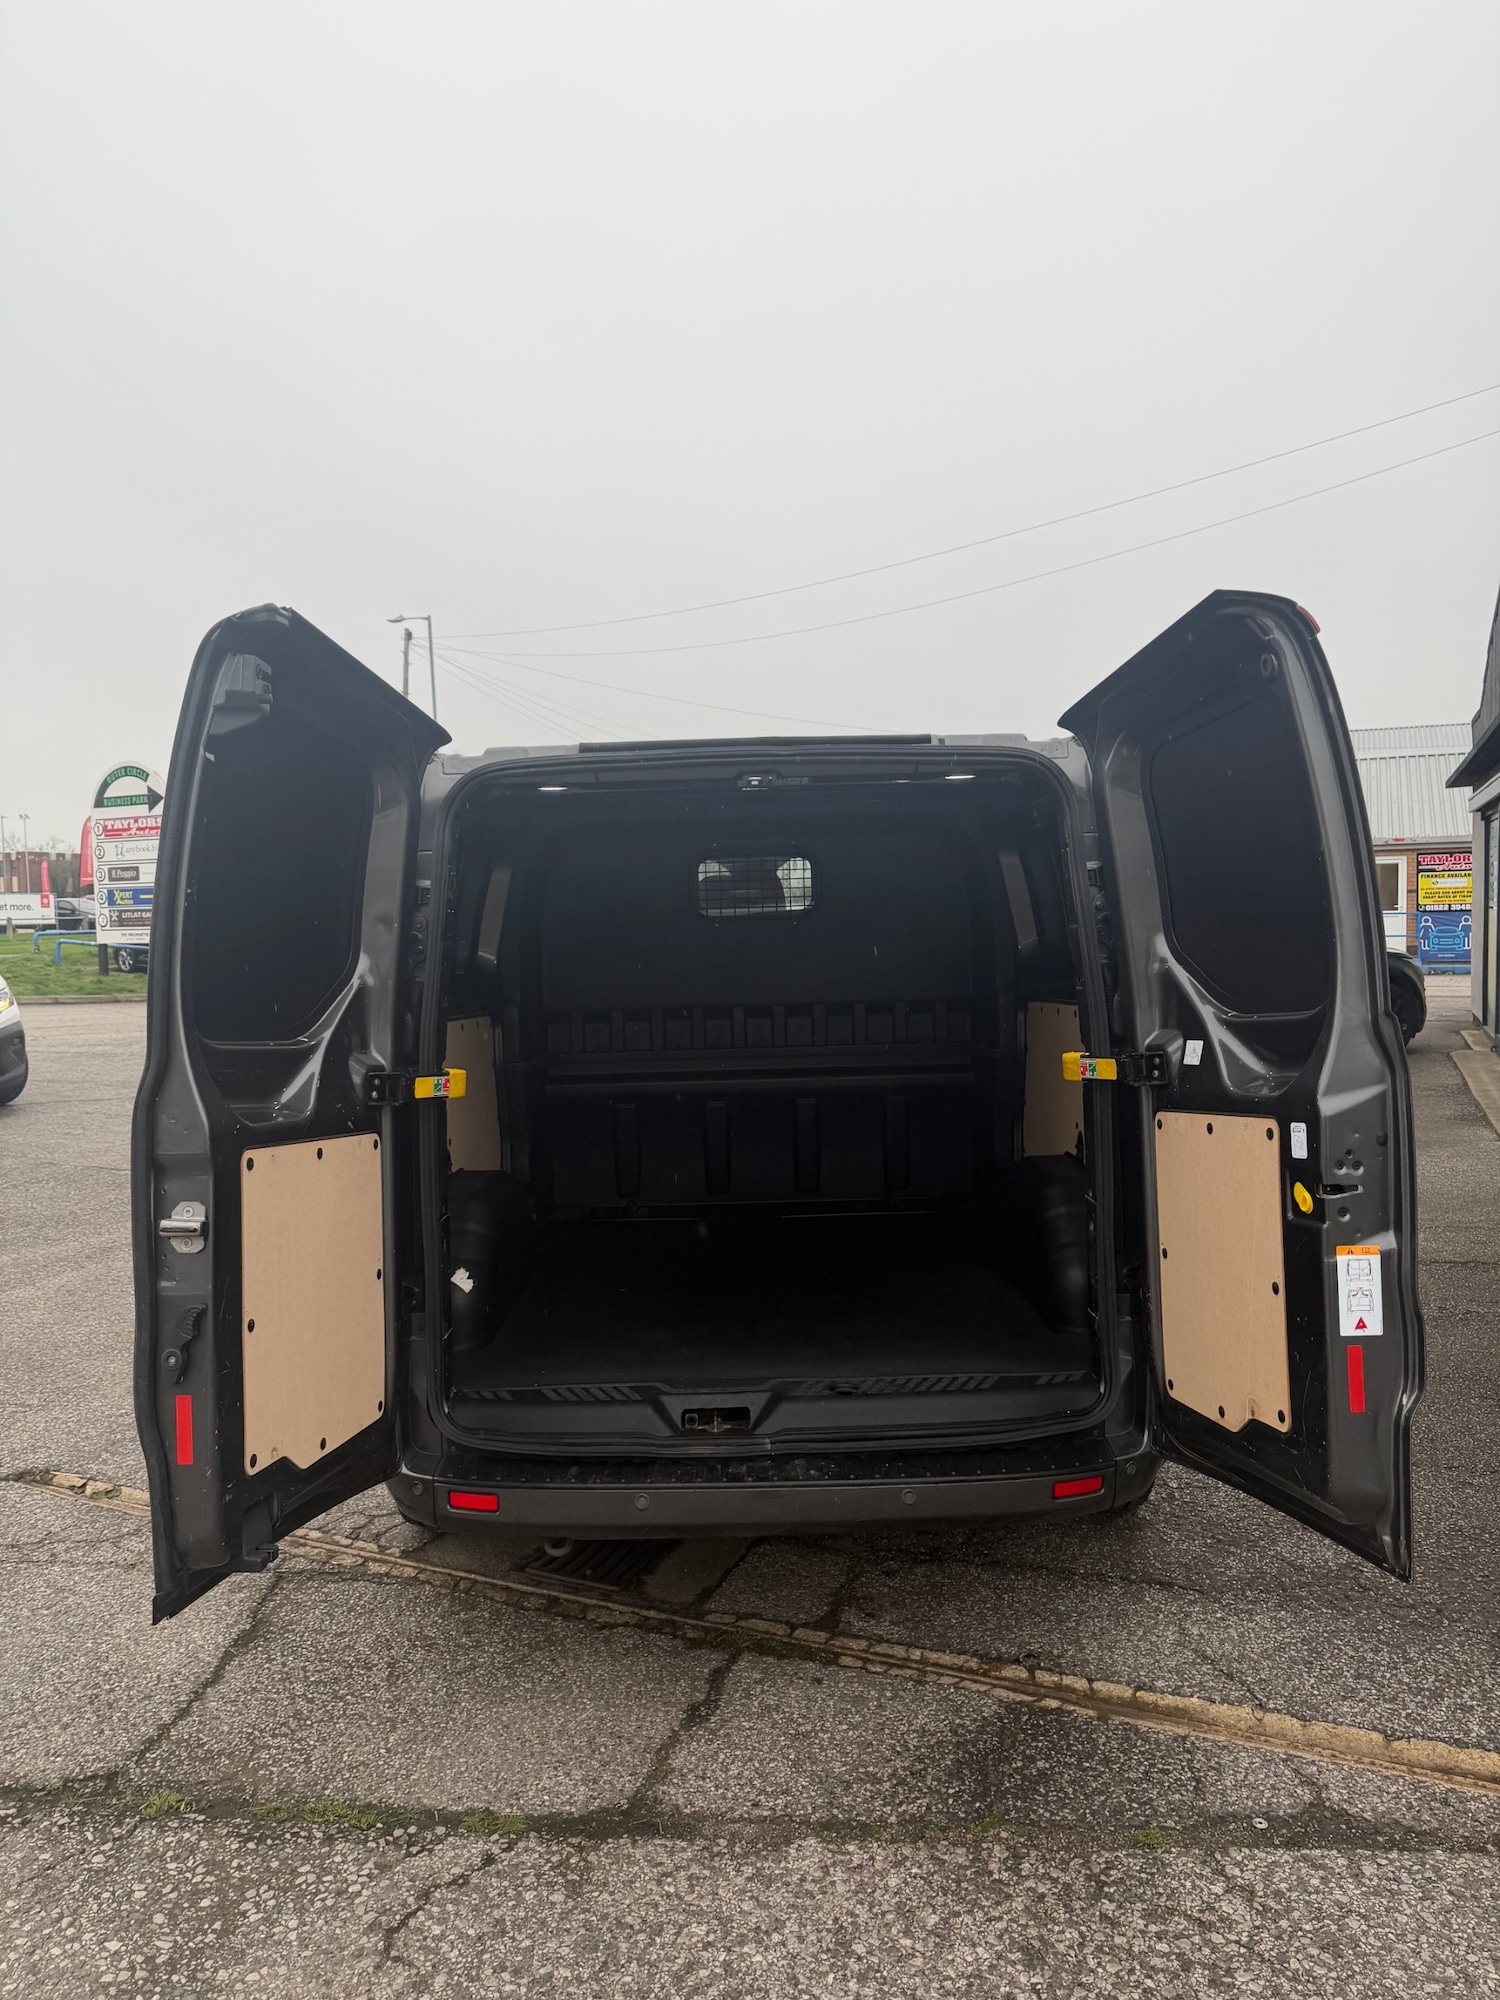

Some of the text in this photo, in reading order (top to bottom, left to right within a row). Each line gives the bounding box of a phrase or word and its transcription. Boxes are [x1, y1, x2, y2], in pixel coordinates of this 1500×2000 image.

[106, 767, 148, 784] OUTER CIRCLE
[103, 795, 148, 807] BUSINESS PARK
[104, 816, 161, 830] TAYLORS
[1418, 853, 1472, 865] TAYLOR
